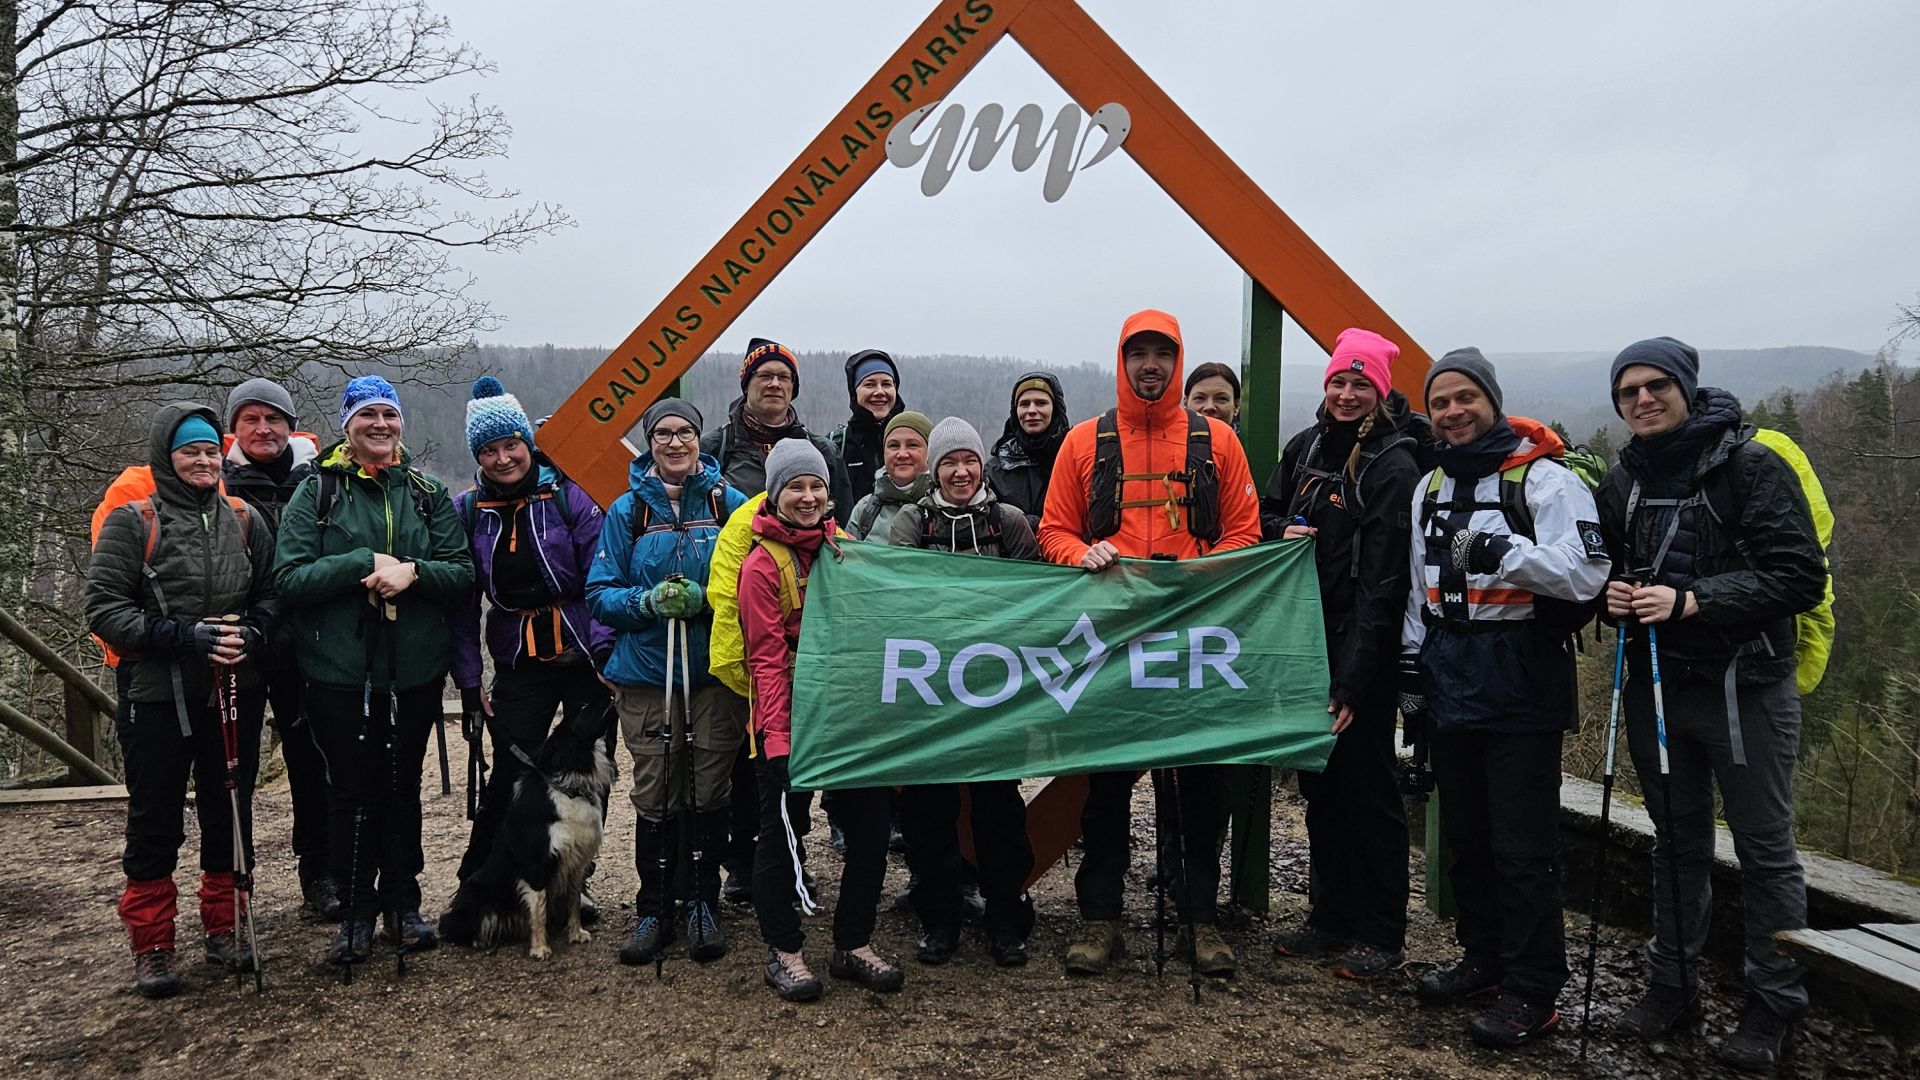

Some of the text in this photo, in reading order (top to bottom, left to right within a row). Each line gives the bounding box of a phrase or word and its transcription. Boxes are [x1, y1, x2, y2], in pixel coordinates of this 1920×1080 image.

[588, 0, 993, 423] GAUJAS NACIONĀLAIS PARKS
[1444, 592, 1463, 603] HH
[229, 674, 237, 721] MILO
